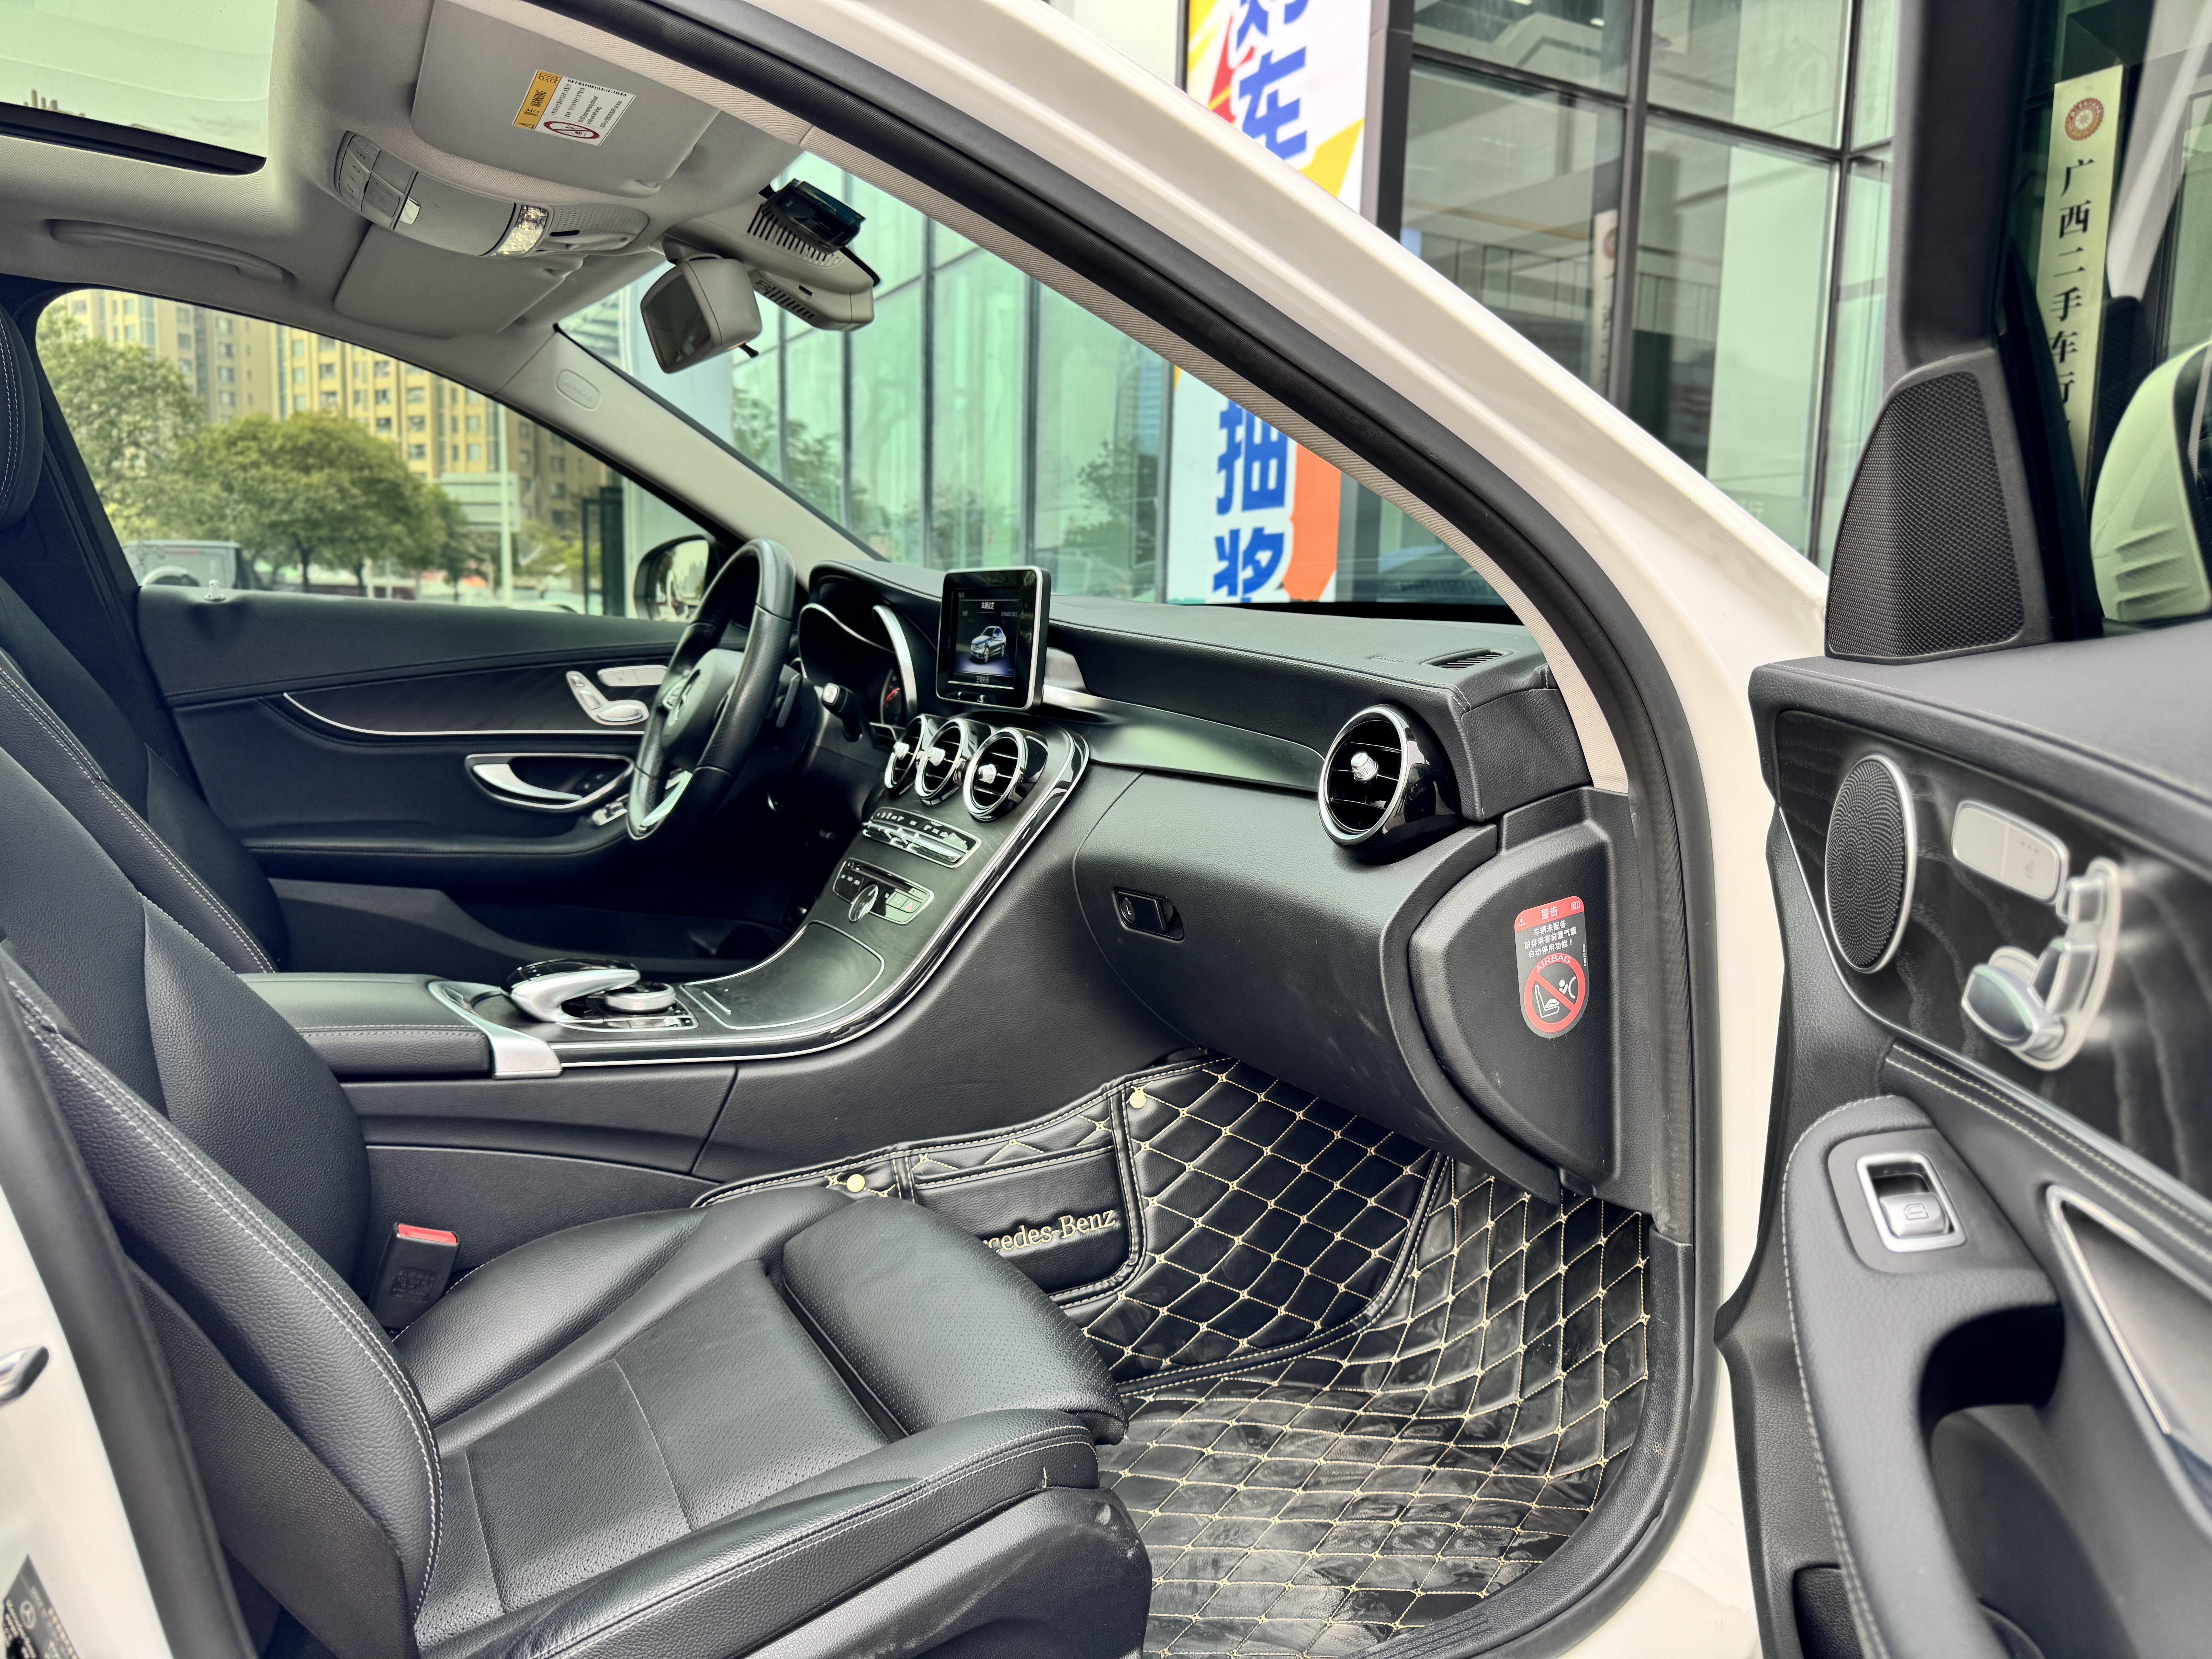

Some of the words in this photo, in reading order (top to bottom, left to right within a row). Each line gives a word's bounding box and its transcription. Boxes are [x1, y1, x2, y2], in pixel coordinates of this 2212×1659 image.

[529, 90, 547, 107] WARNING
[2047, 158, 2095, 429] 广西二手车行
[1540, 905, 1559, 921] 警告
[1533, 920, 1566, 936] 车辆未配备
[1536, 954, 1571, 974] AIRBAG
[982, 1209, 1116, 1253] cedes-Benz
